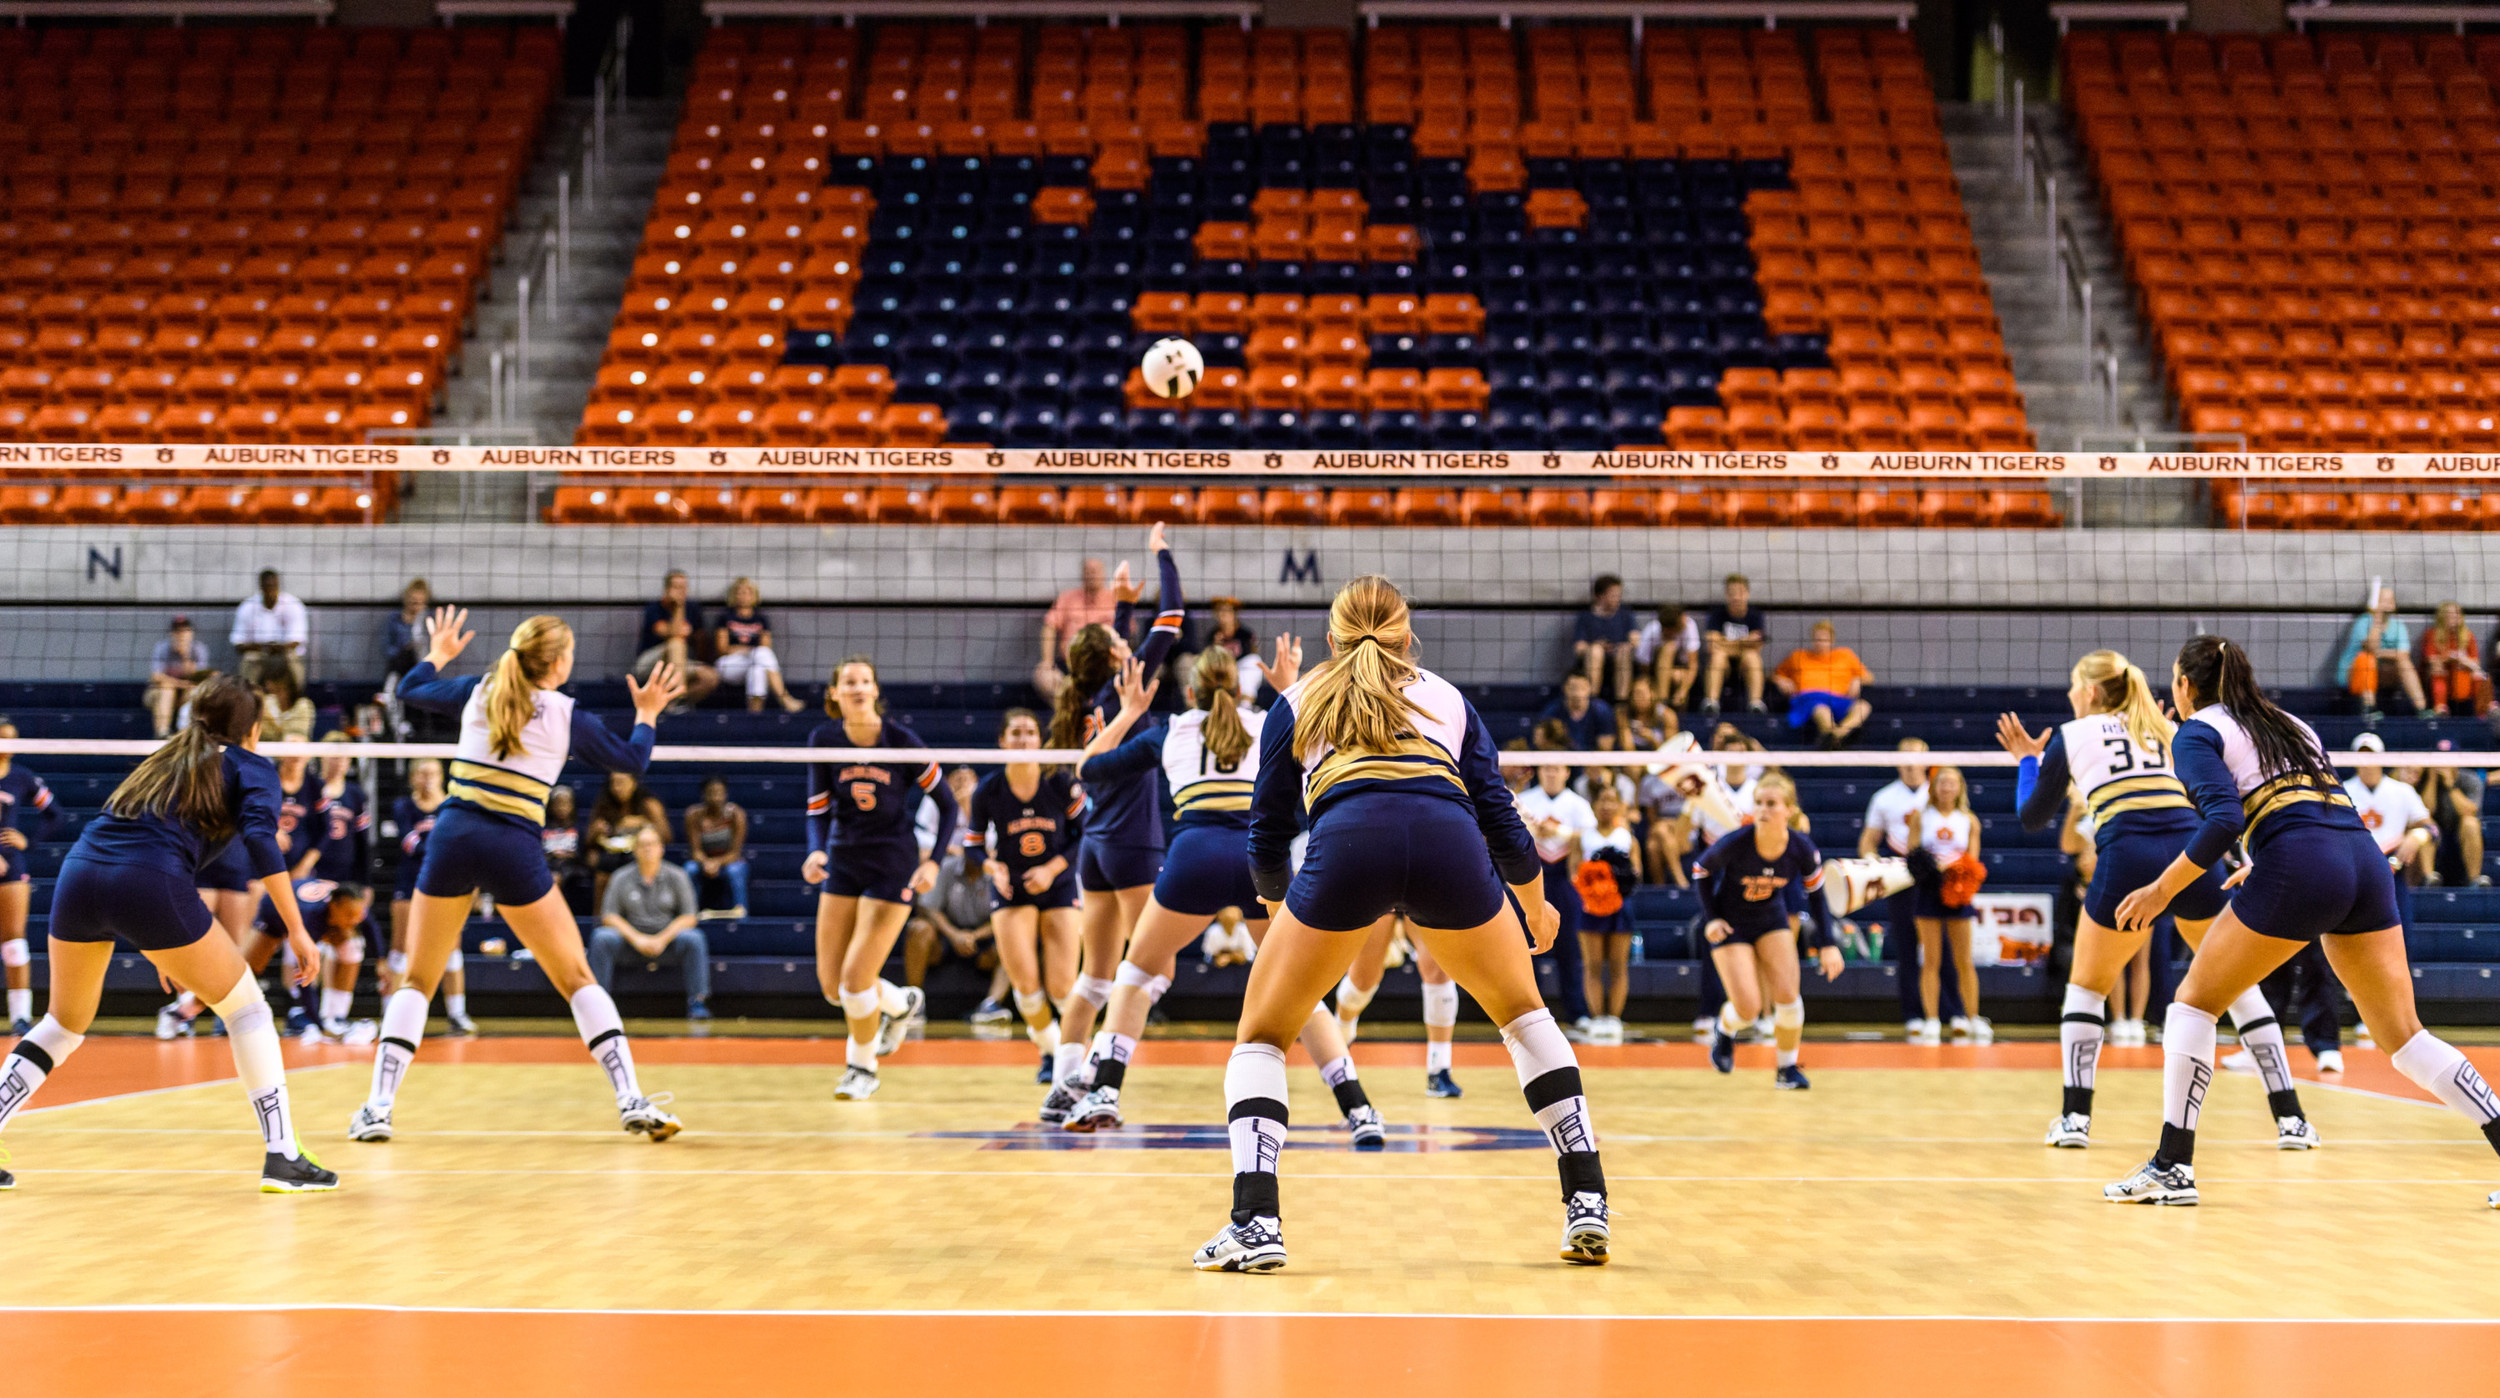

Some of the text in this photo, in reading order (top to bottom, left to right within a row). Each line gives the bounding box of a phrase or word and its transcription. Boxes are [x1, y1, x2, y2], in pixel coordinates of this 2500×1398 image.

[37, 448, 122, 463] TIGERS
[205, 449, 304, 464] AUBURN
[312, 449, 397, 465] TIGERS
[481, 450, 582, 465] AUBURN
[589, 451, 676, 466] TIGERS
[758, 451, 858, 466] AUBURN
[866, 452, 953, 467] TIGERS
[1034, 452, 1136, 467] AUBURN
[1143, 453, 1231, 468] TIGERS
[1313, 453, 1415, 468] AUBURN
[1421, 454, 1510, 469] TIGERS
[1591, 454, 1692, 469] AUBURN
[1700, 455, 1787, 470] TIGERS
[1870, 455, 1971, 470] AUBURN
[1978, 456, 2065, 471] TIGERS
[2148, 457, 2249, 472] AUBURN
[2256, 457, 2343, 472] TIGERS
[88, 546, 122, 581] N
[1280, 549, 1319, 584] M
[851, 782, 877, 811] 5
[1020, 832, 1046, 857] 8
